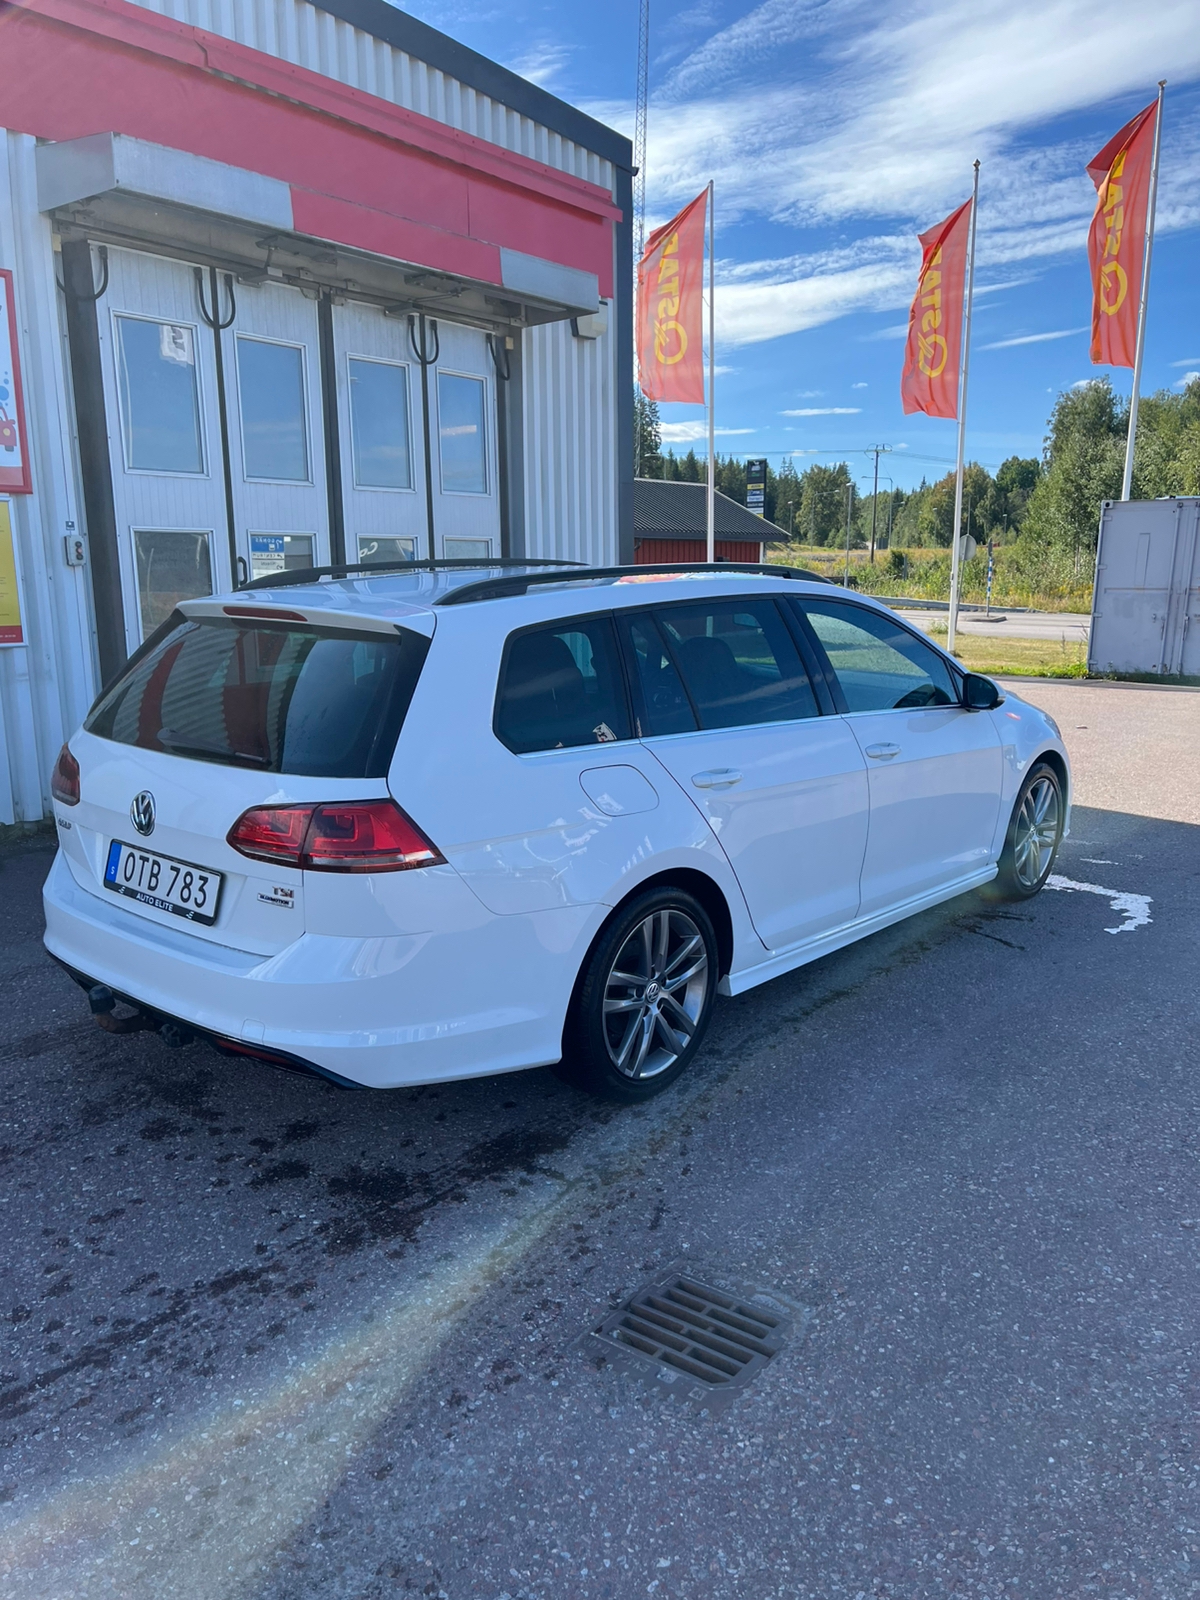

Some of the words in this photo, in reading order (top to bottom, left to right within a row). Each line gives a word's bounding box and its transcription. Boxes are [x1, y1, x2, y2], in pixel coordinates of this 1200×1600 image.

[110, 866, 116, 875] S
[123, 851, 161, 892] OTB
[166, 865, 209, 908] 783
[136, 892, 155, 904] AUTO
[154, 898, 174, 912] ELITE
